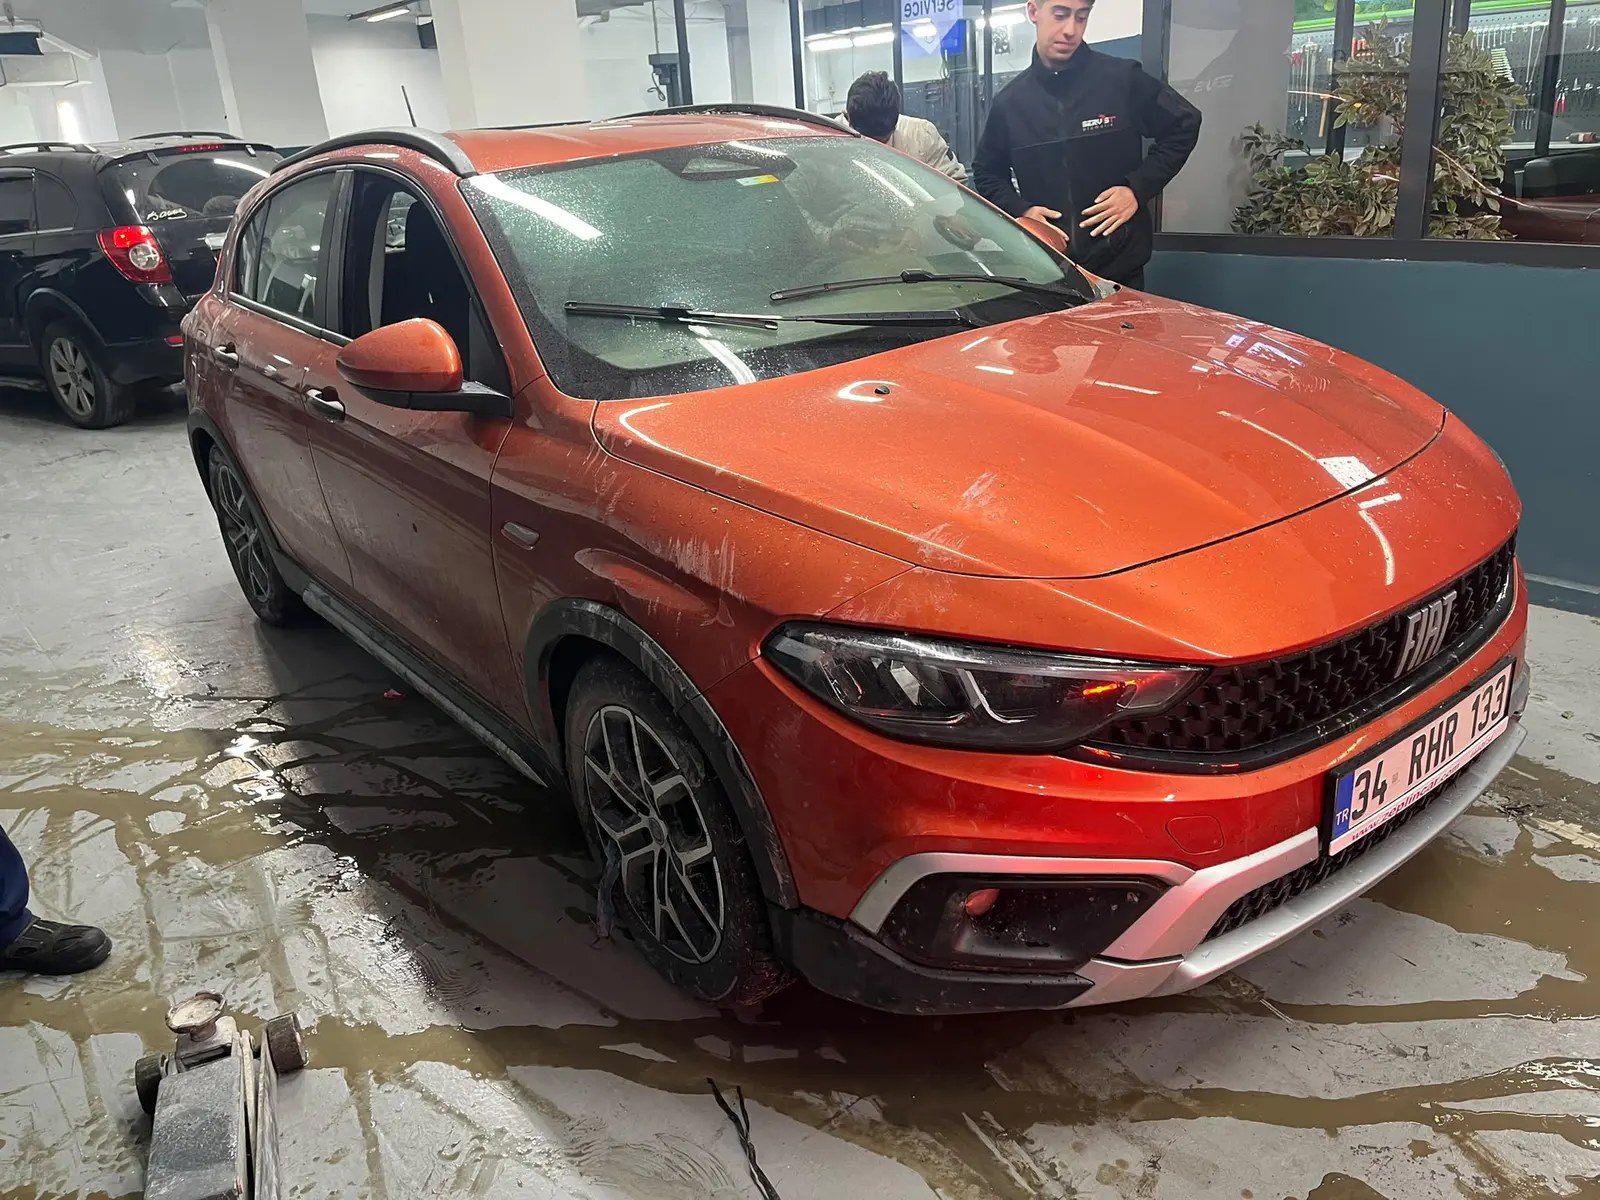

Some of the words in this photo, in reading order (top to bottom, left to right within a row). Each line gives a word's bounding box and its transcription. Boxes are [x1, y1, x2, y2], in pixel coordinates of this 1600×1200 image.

[1394, 590, 1458, 679] FIAT
[1351, 760, 1388, 821] 34
[1408, 711, 1459, 786] RHR
[1471, 674, 1507, 740] 133
[1336, 808, 1349, 826] TR
[1351, 763, 1461, 841] www.zeplincar.com
